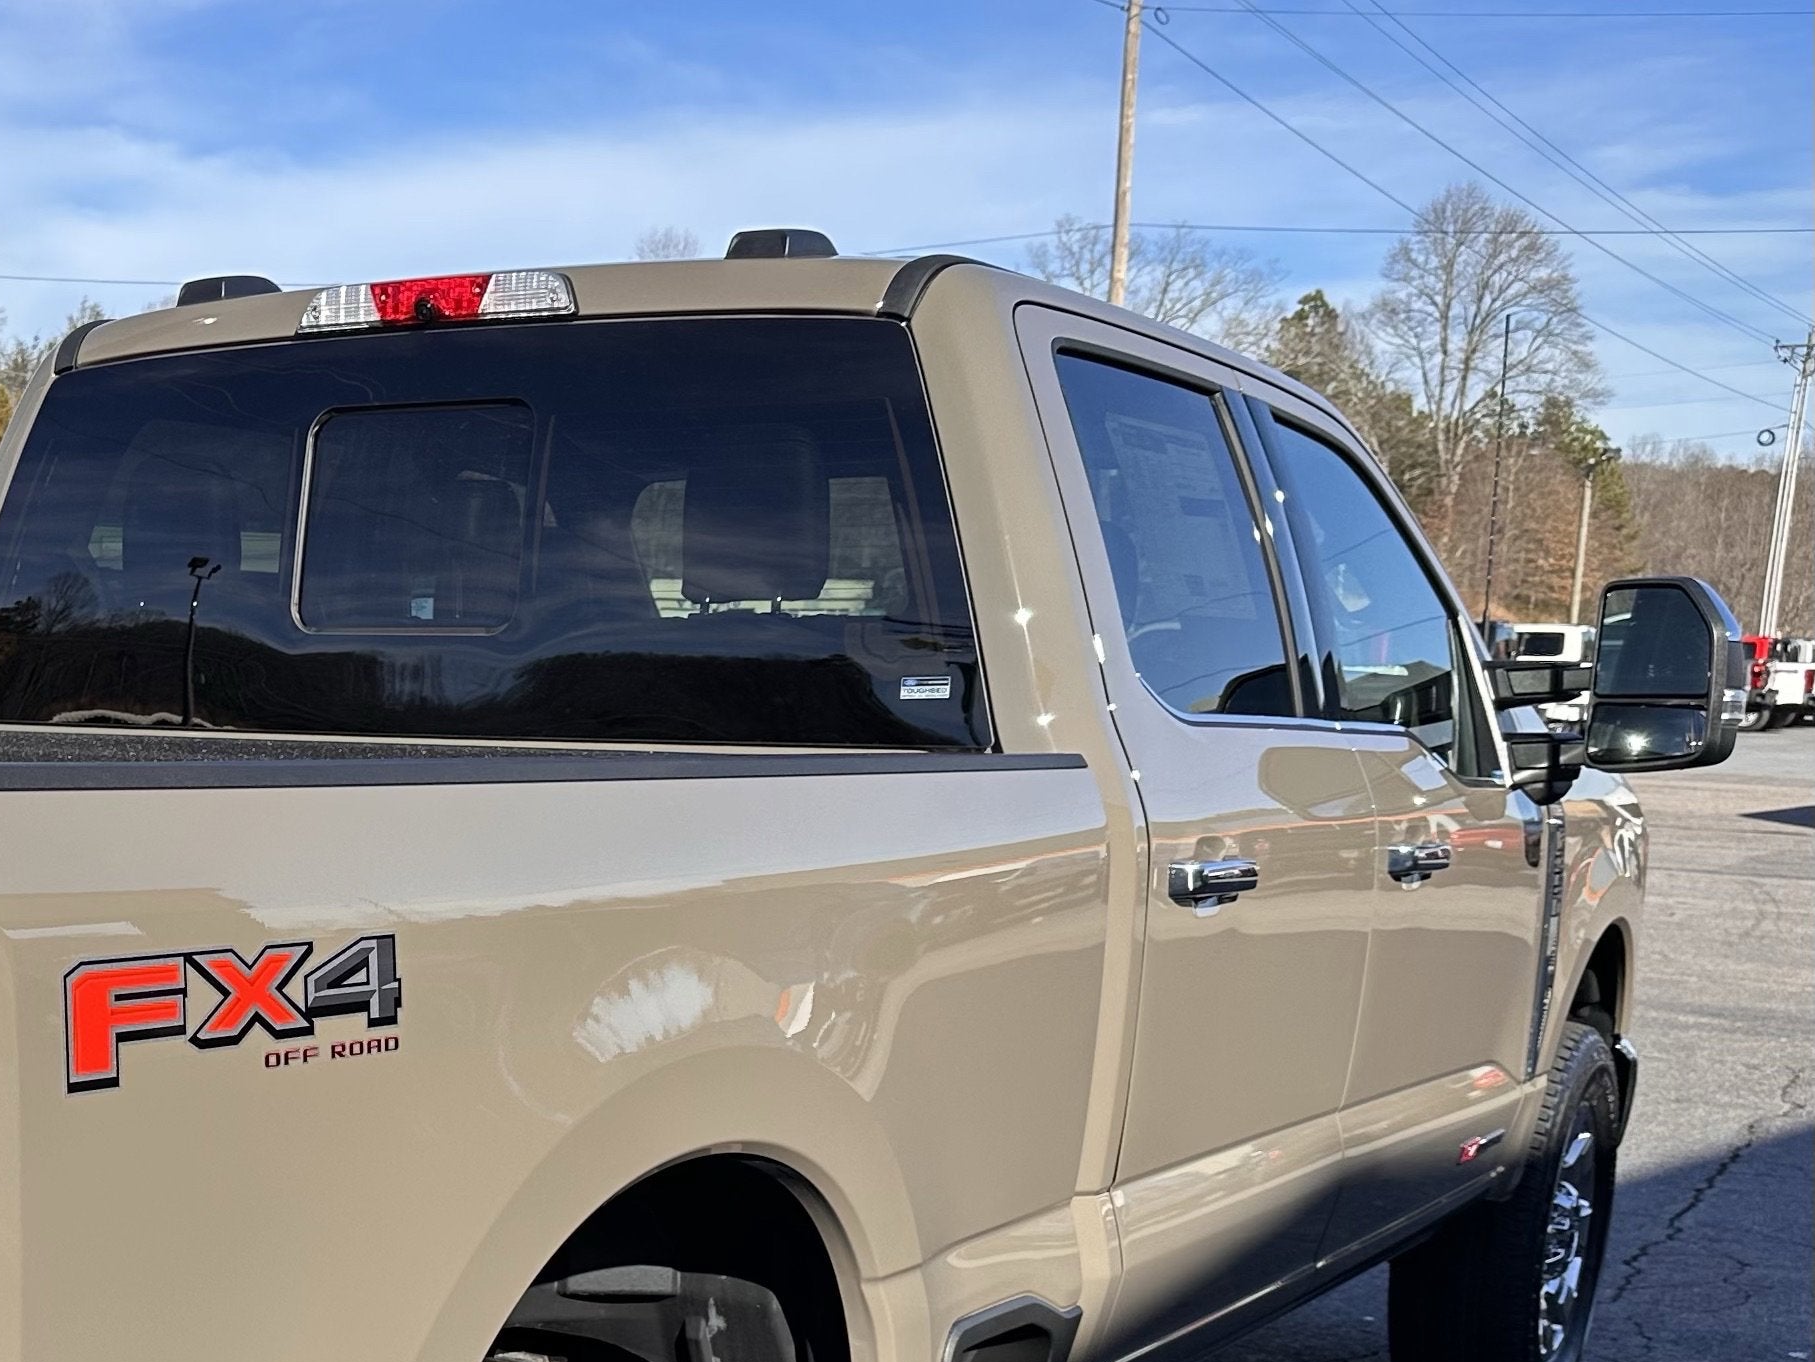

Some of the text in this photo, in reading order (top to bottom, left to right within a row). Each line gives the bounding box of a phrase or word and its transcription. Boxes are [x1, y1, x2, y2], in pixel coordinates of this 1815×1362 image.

[63, 932, 402, 1096] FX4
[265, 1036, 399, 1068] OFF ROAD
